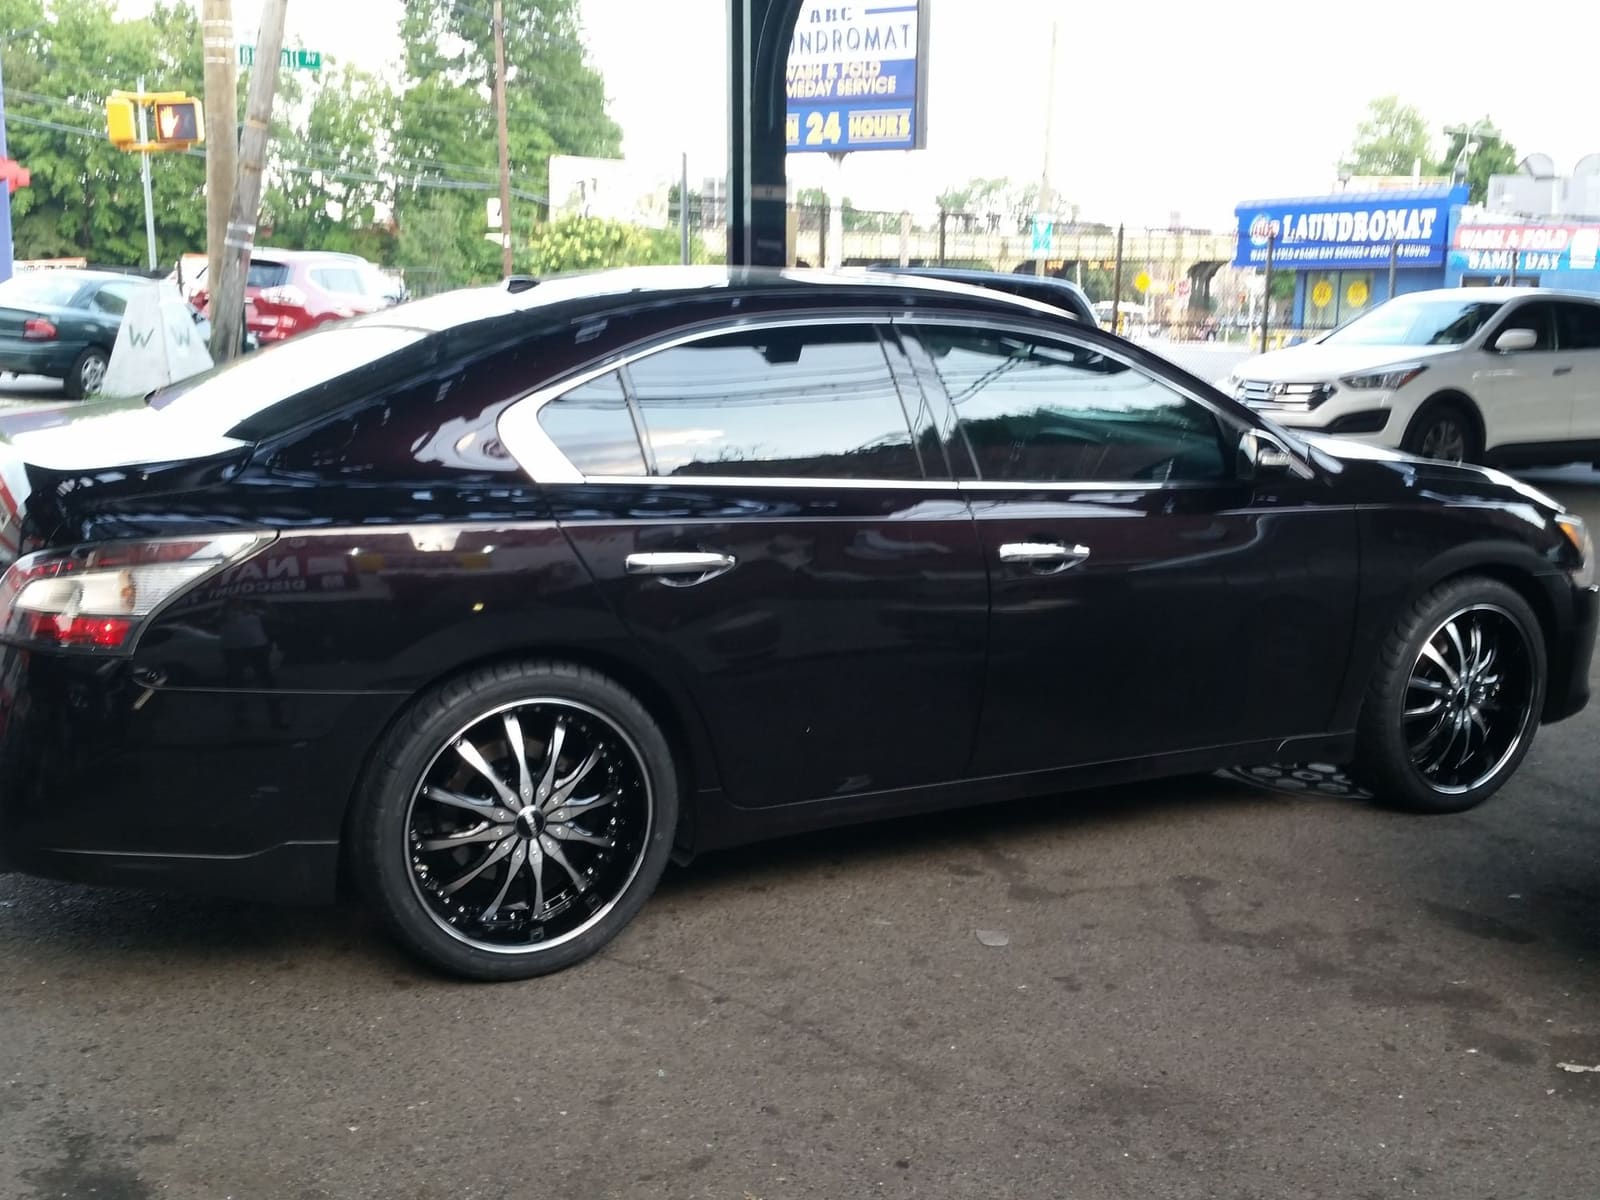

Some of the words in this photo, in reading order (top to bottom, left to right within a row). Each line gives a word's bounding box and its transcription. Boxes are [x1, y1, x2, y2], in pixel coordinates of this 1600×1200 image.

[791, 24, 911, 55] NDROMAT
[787, 78, 834, 98] MEDAY
[837, 75, 896, 96] SERVICE
[806, 111, 842, 145] 24
[849, 112, 911, 140] HOURS
[1281, 207, 1438, 244] LAUNDROMAT
[1520, 229, 1568, 250] FOLD
[1524, 251, 1562, 270] DAY
